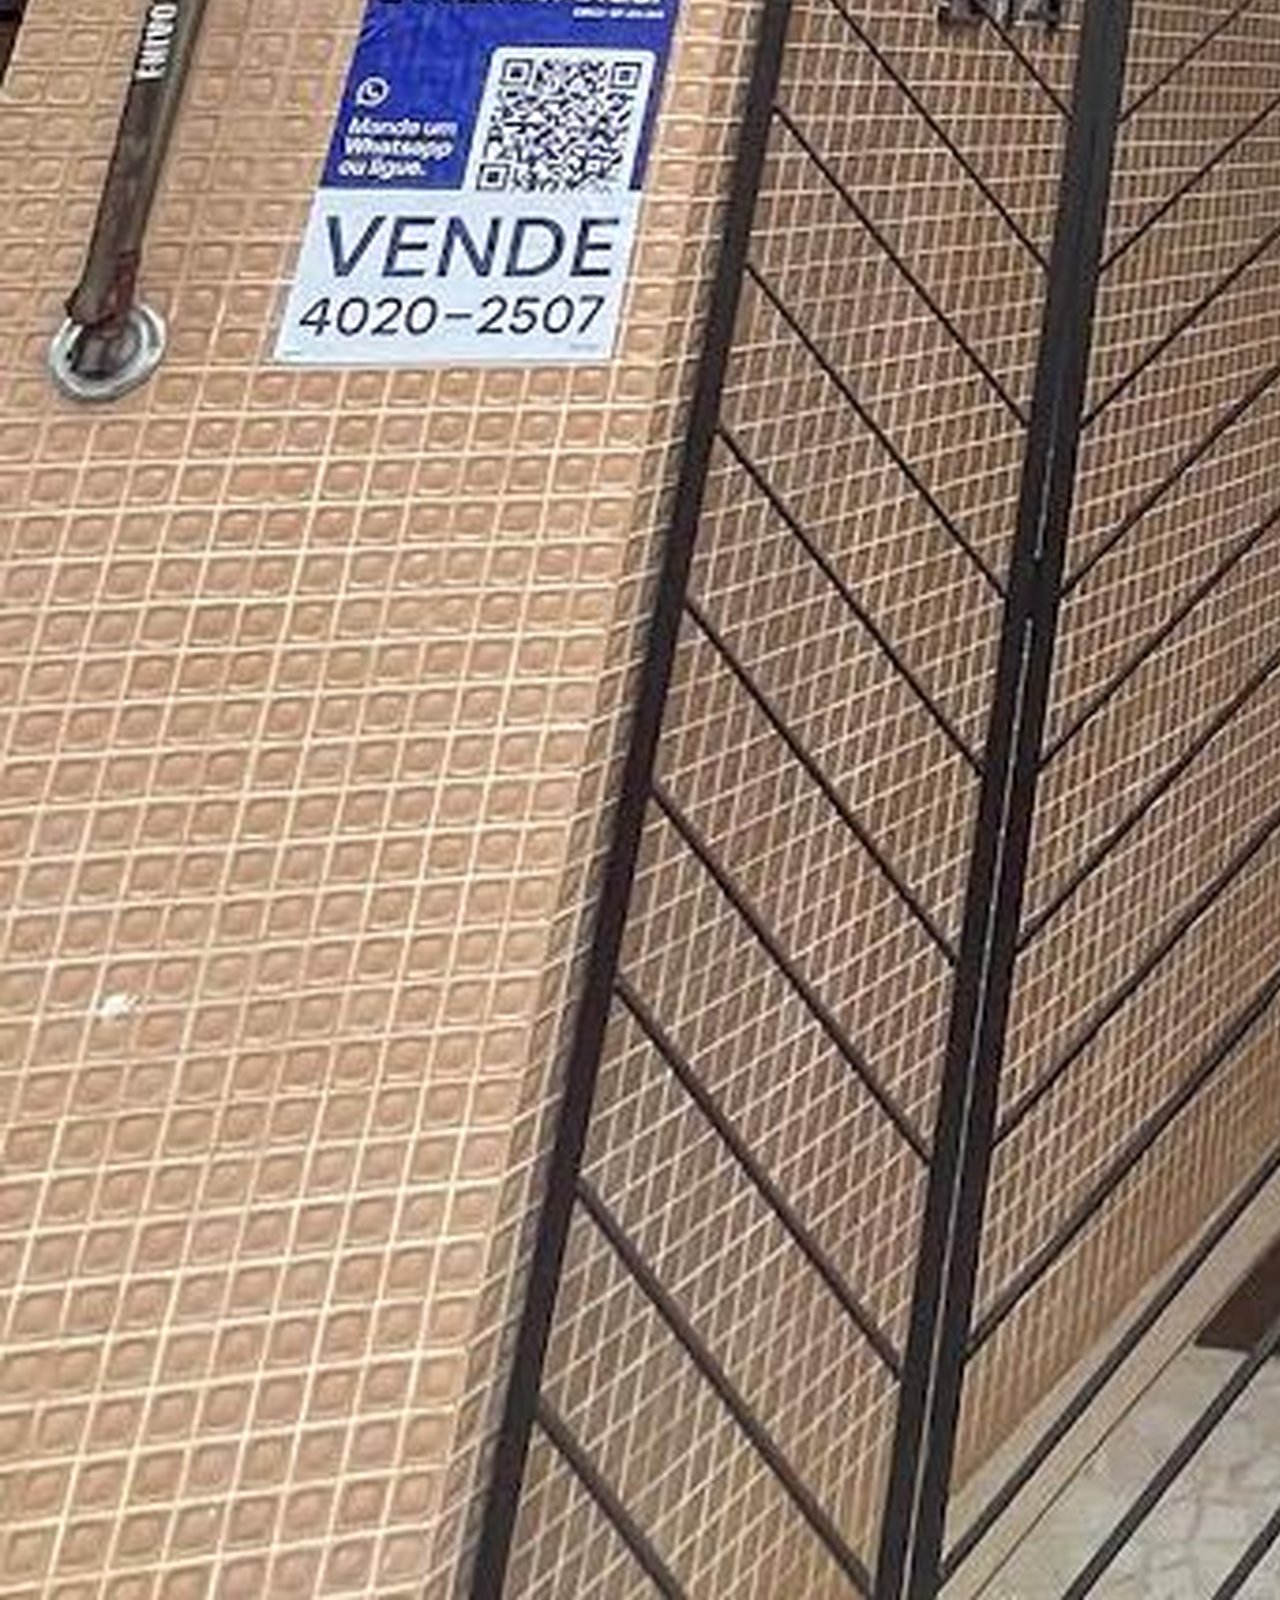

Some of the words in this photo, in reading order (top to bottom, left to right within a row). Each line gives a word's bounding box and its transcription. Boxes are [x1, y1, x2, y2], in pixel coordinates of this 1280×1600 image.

[348, 116, 421, 136] Mande
[423, 120, 459, 137] um
[337, 160, 367, 176] ou
[367, 158, 427, 180] ligue.
[326, 215, 620, 278] VENDE
[298, 294, 606, 337] 4020-2507
